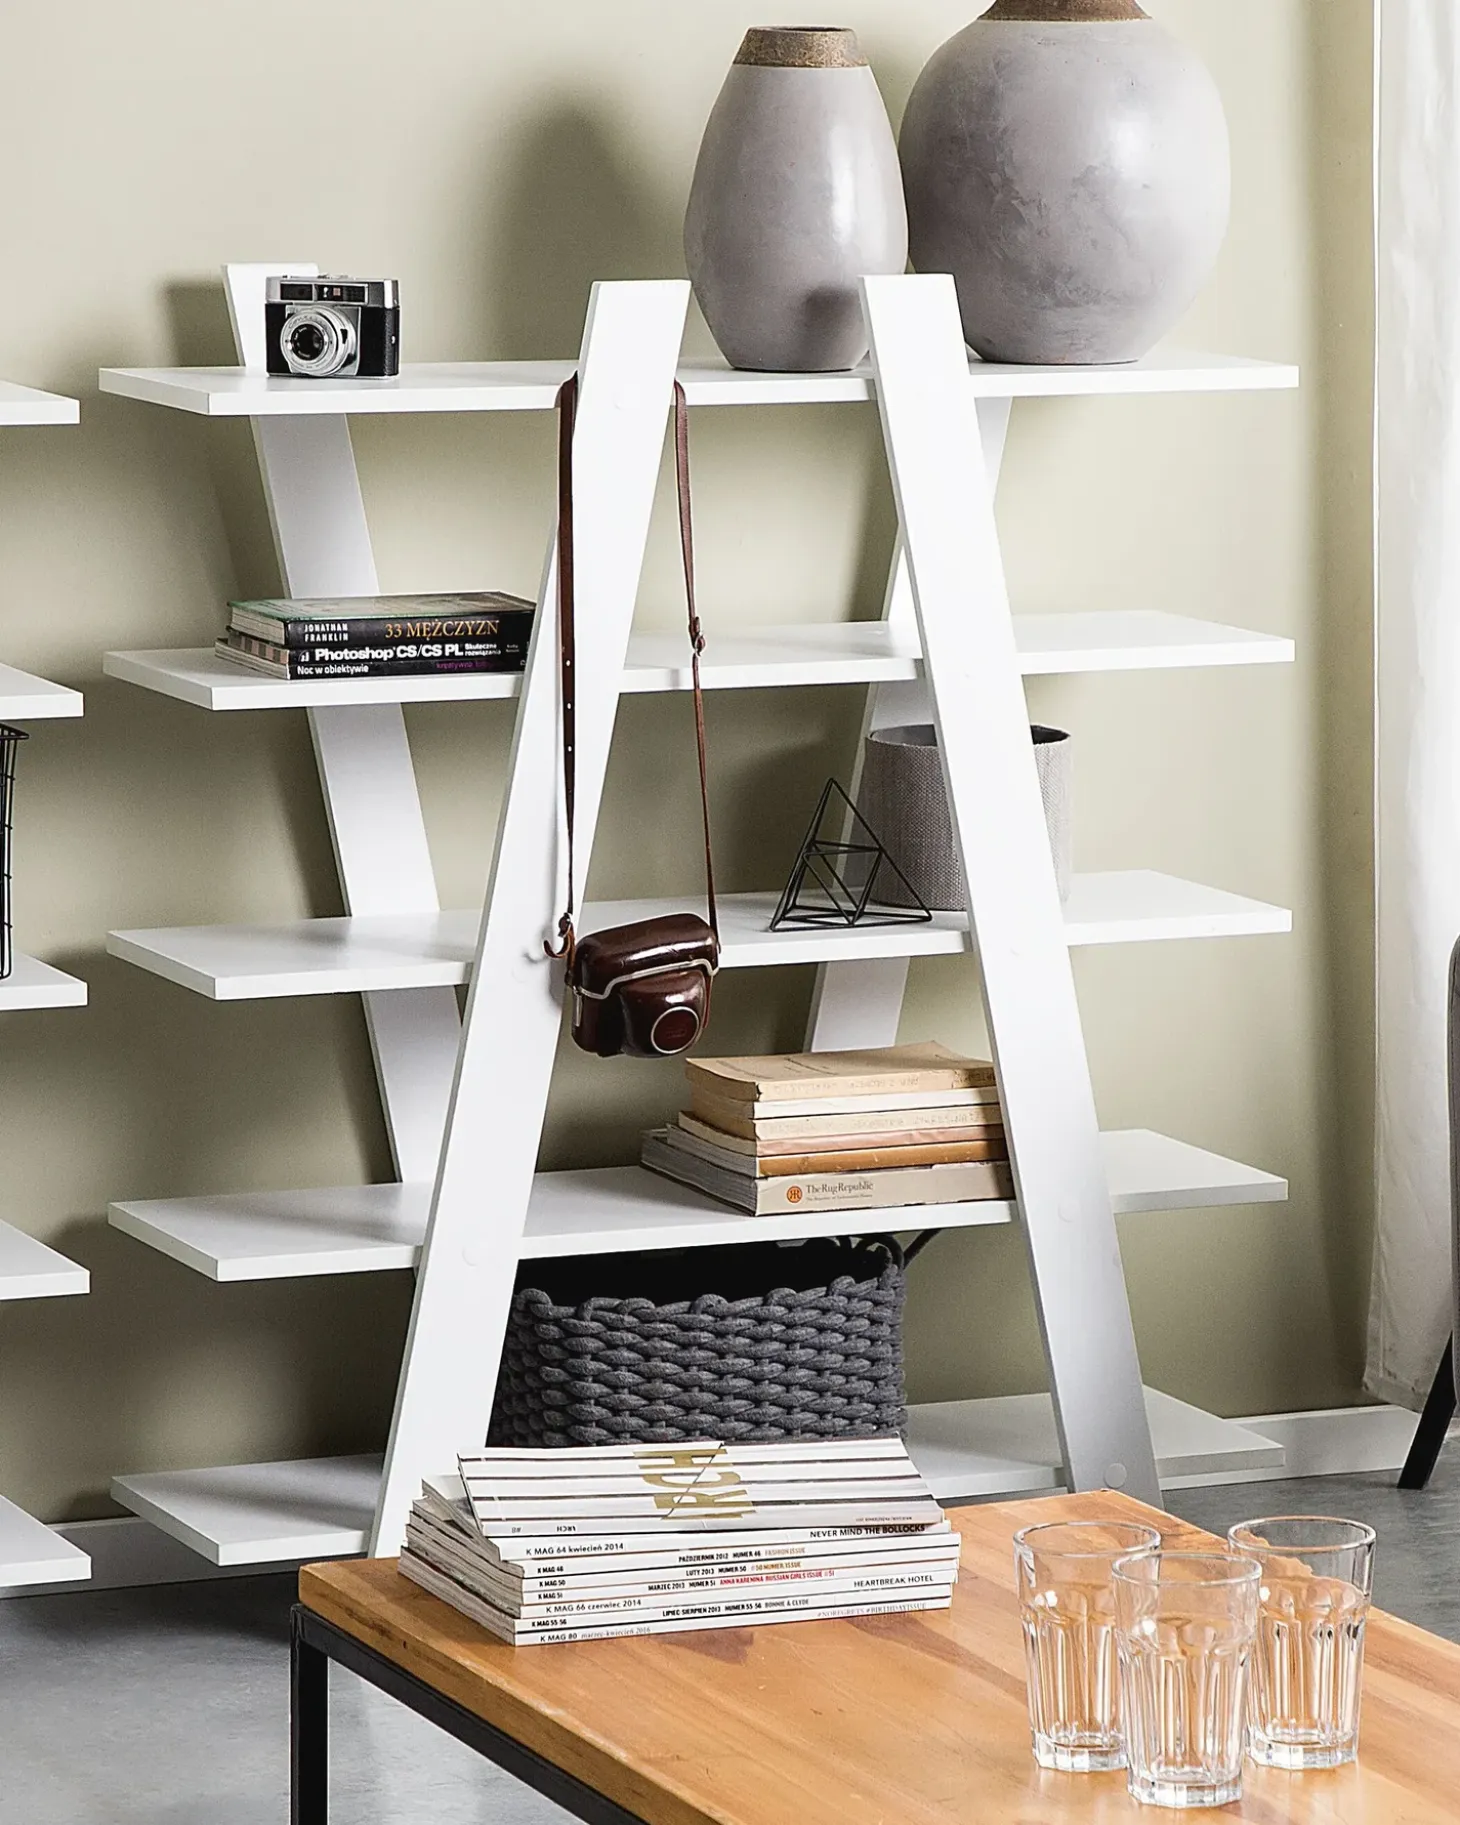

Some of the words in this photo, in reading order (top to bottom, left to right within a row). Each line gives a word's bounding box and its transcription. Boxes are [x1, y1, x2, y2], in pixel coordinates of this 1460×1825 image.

[305, 624, 348, 632] JONATHAN
[385, 624, 402, 638] 33
[407, 619, 500, 640] MĘŻCZYZN
[305, 633, 348, 642] FRANKLIN
[397, 644, 442, 658] CS/CS
[444, 644, 464, 656] PL
[298, 666, 314, 675] Noc
[324, 664, 369, 674] obiektywie
[810, 1530, 837, 1538] NEVER
[840, 1528, 862, 1536] MIND
[864, 1526, 880, 1535] THE
[882, 1524, 925, 1534] BOLLOCKS
[568, 1544, 602, 1552] kwiecień
[604, 1542, 624, 1550] 2014
[854, 1576, 906, 1588] HEARTBREAK
[908, 1574, 933, 1582] HOTEL
[554, 1604, 574, 1612] MAG
[588, 1602, 620, 1610] czerwiec
[622, 1600, 642, 1608] 2014
[548, 1634, 566, 1642] MAG
